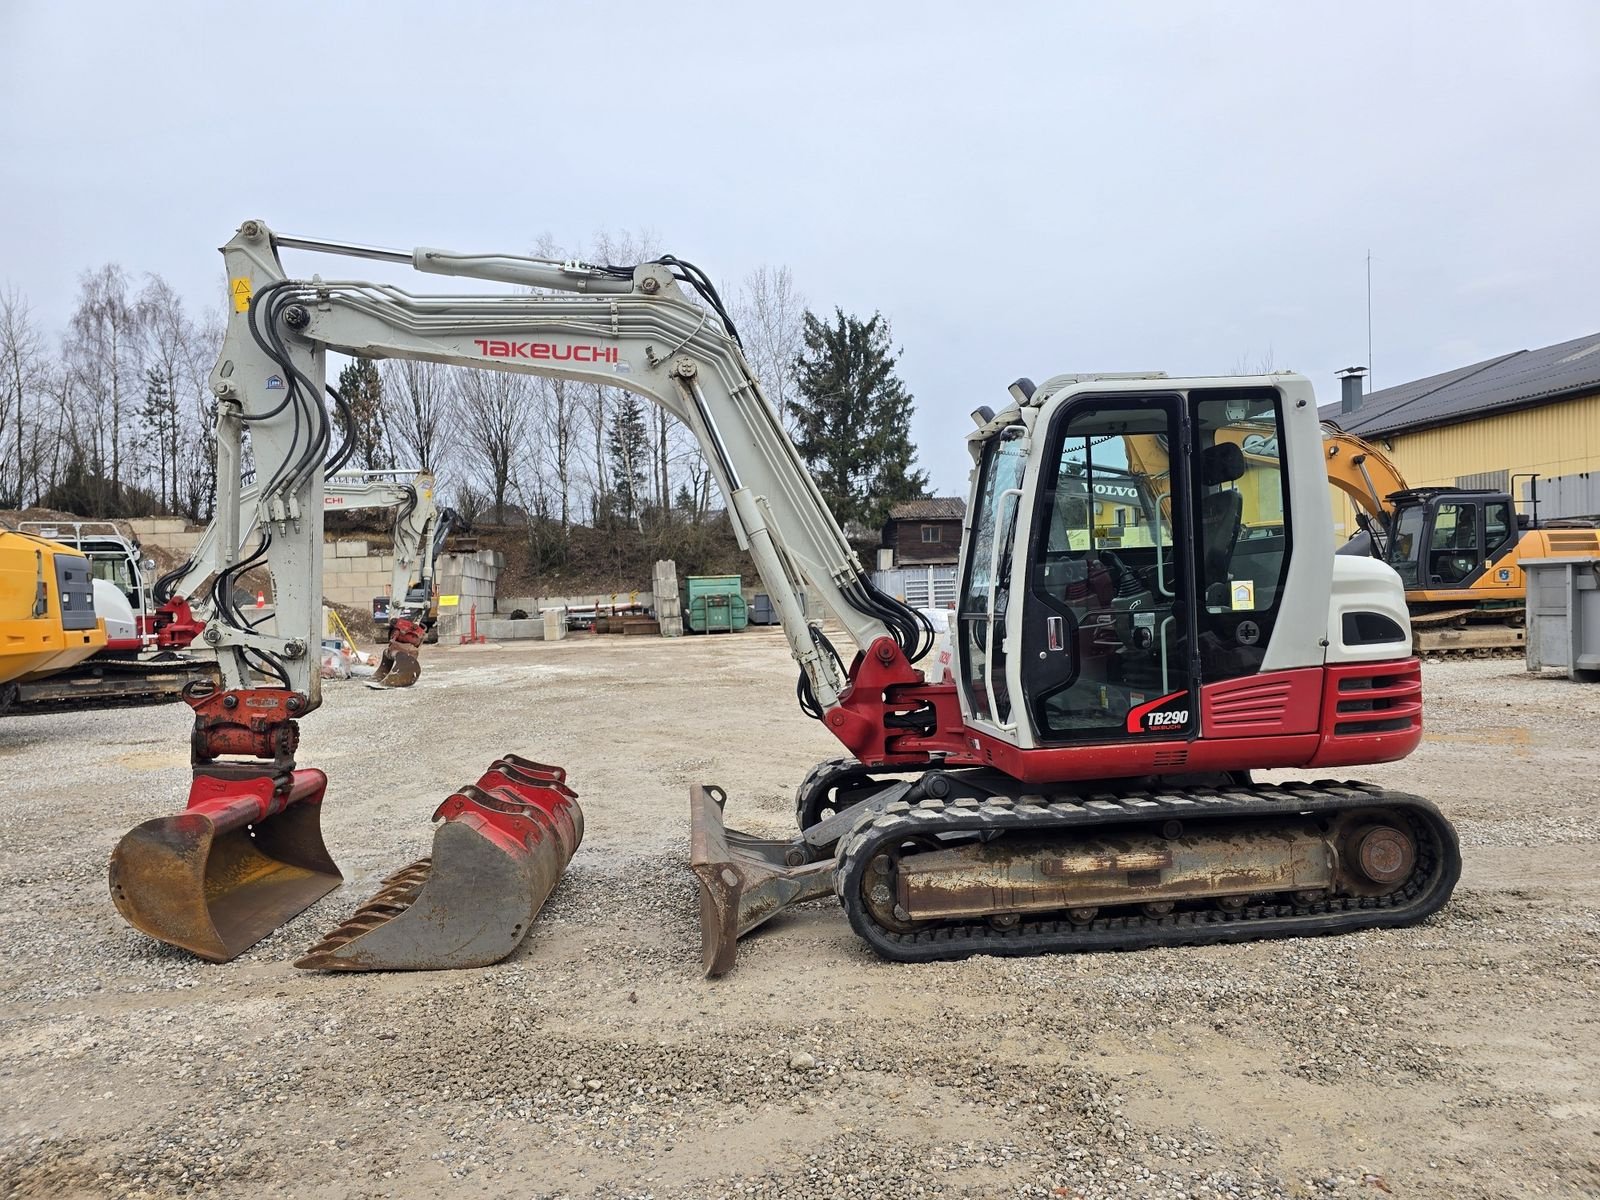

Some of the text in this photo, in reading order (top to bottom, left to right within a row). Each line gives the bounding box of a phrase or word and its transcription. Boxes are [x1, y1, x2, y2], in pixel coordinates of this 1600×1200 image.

[474, 339, 618, 363] TAKEUCHI
[1081, 482, 1138, 497] VOLVO
[1147, 710, 1188, 725] TB290
